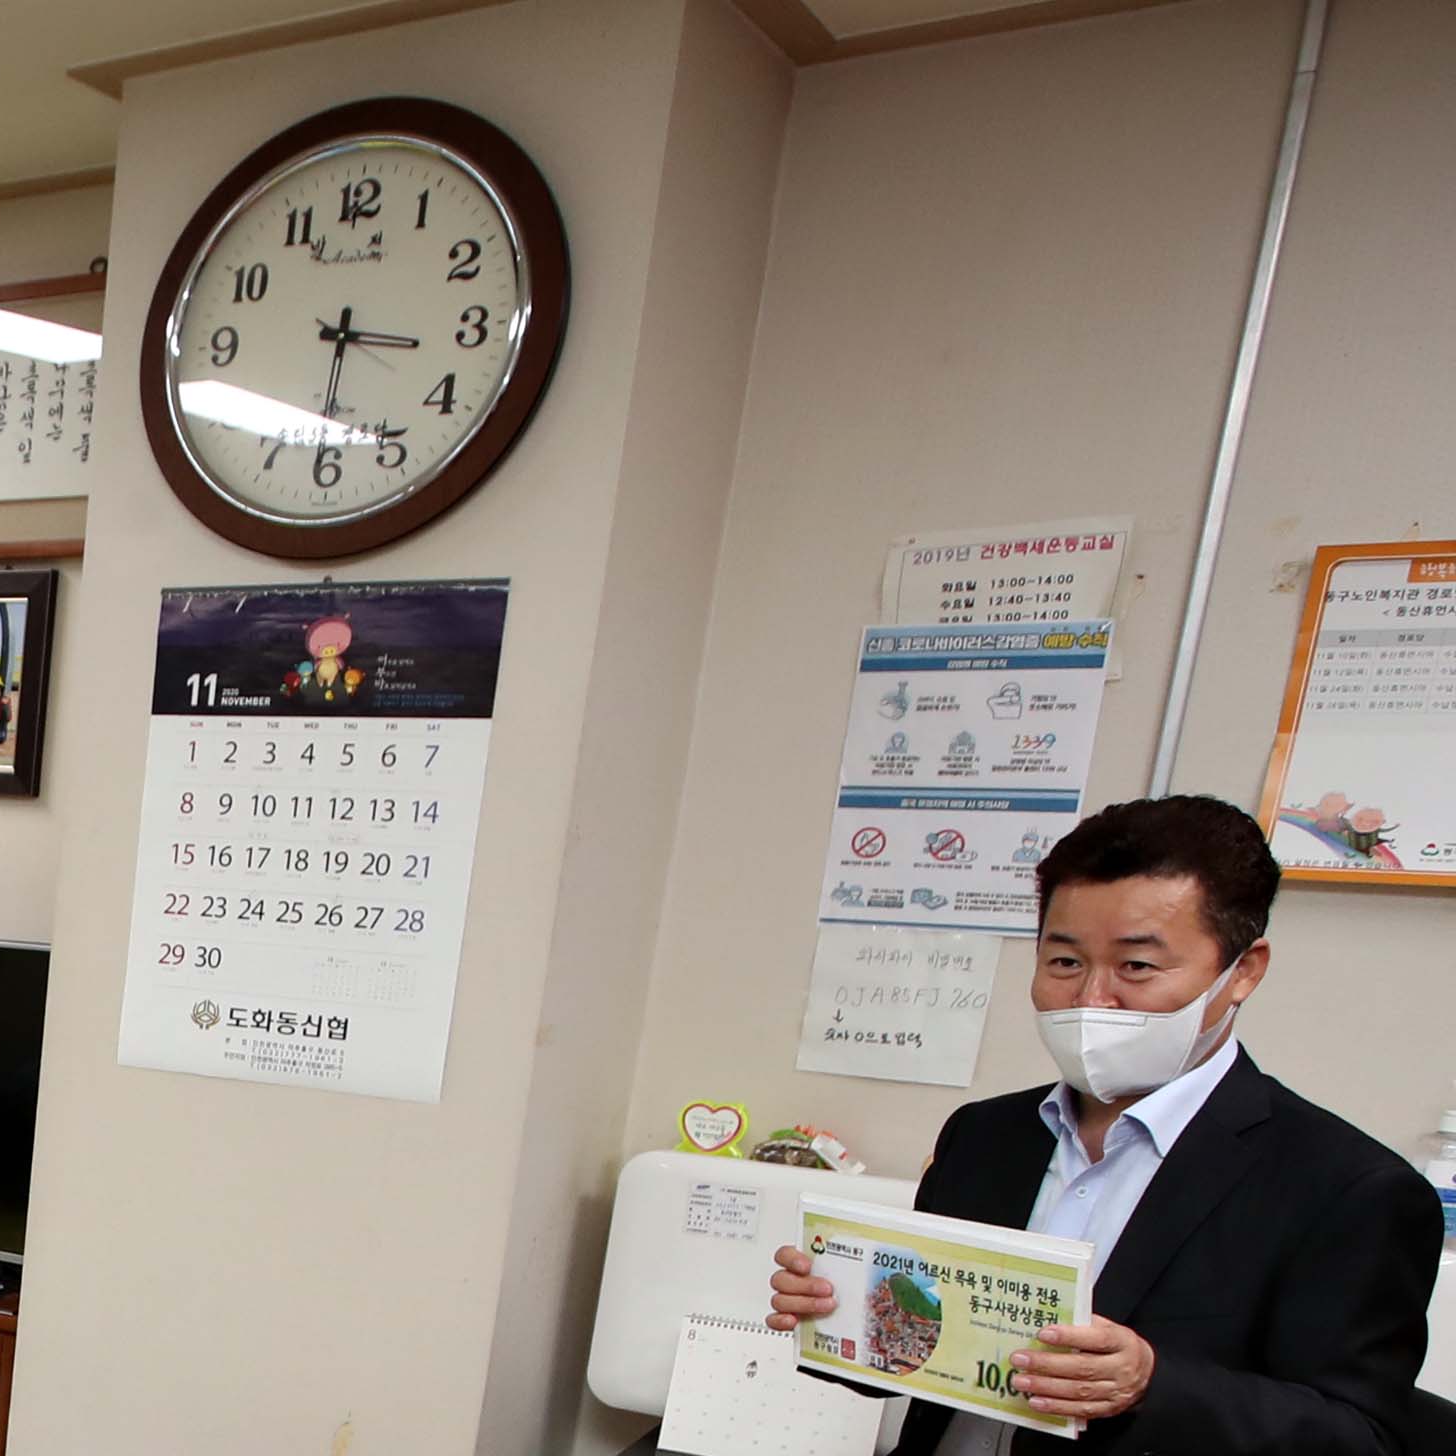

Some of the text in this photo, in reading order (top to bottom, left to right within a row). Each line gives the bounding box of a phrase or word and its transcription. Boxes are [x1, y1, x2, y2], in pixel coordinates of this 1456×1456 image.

[339, 177, 382, 224] 12
[414, 189, 429, 229] 1
[284, 207, 313, 246] 11
[447, 239, 482, 282] 2
[233, 263, 268, 302] 10
[456, 305, 488, 348] 3
[211, 327, 239, 367] 9
[423, 373, 457, 415] 4
[260, 436, 287, 470] 7
[376, 427, 408, 468] 5
[313, 446, 342, 488] 6
[913, 534, 1115, 566] 2019년 건강백세운동교실
[1426, 588, 1456, 600] 경로
[186, 672, 218, 707] 11
[220, 696, 271, 706] NOVEMBER
[188, 741, 439, 768] 1 2 3 4 5 6 7
[1012, 733, 1057, 750] 1339
[180, 792, 439, 824] 8 9 10 11 12 13 14
[171, 843, 431, 879] 15 16 17 18 19 20 21
[163, 893, 425, 933] 22 23 24 25 26 27 28
[158, 943, 222, 969] 29 30
[226, 1007, 349, 1041] 도화동신협
[873, 1251, 1061, 1308] 2021년 어르신 목욕 및 이미용 전용
[969, 1295, 1059, 1328] 동구사랑상품권
[688, 1328, 696, 1341] 8
